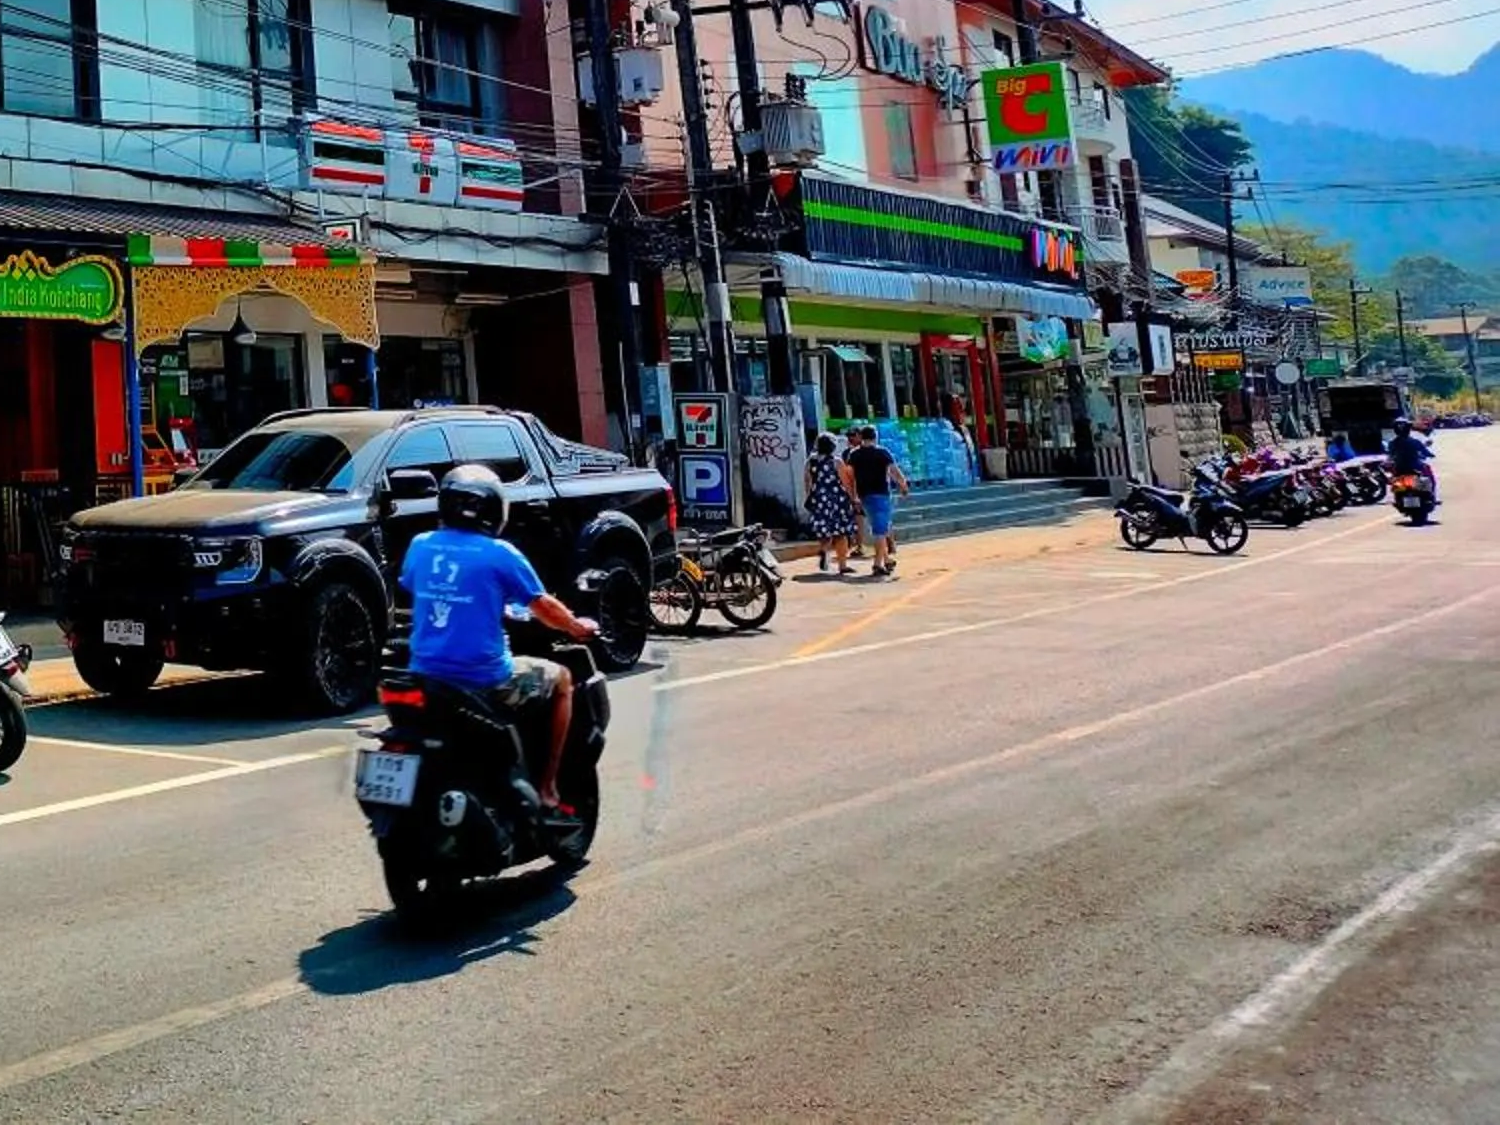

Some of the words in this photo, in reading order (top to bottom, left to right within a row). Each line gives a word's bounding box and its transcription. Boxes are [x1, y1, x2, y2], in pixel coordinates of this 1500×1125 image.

[996, 78, 1028, 95] Big
[1001, 73, 1052, 135] C
[995, 140, 1070, 170] mini
[3, 280, 37, 307] India
[684, 460, 722, 499] P
